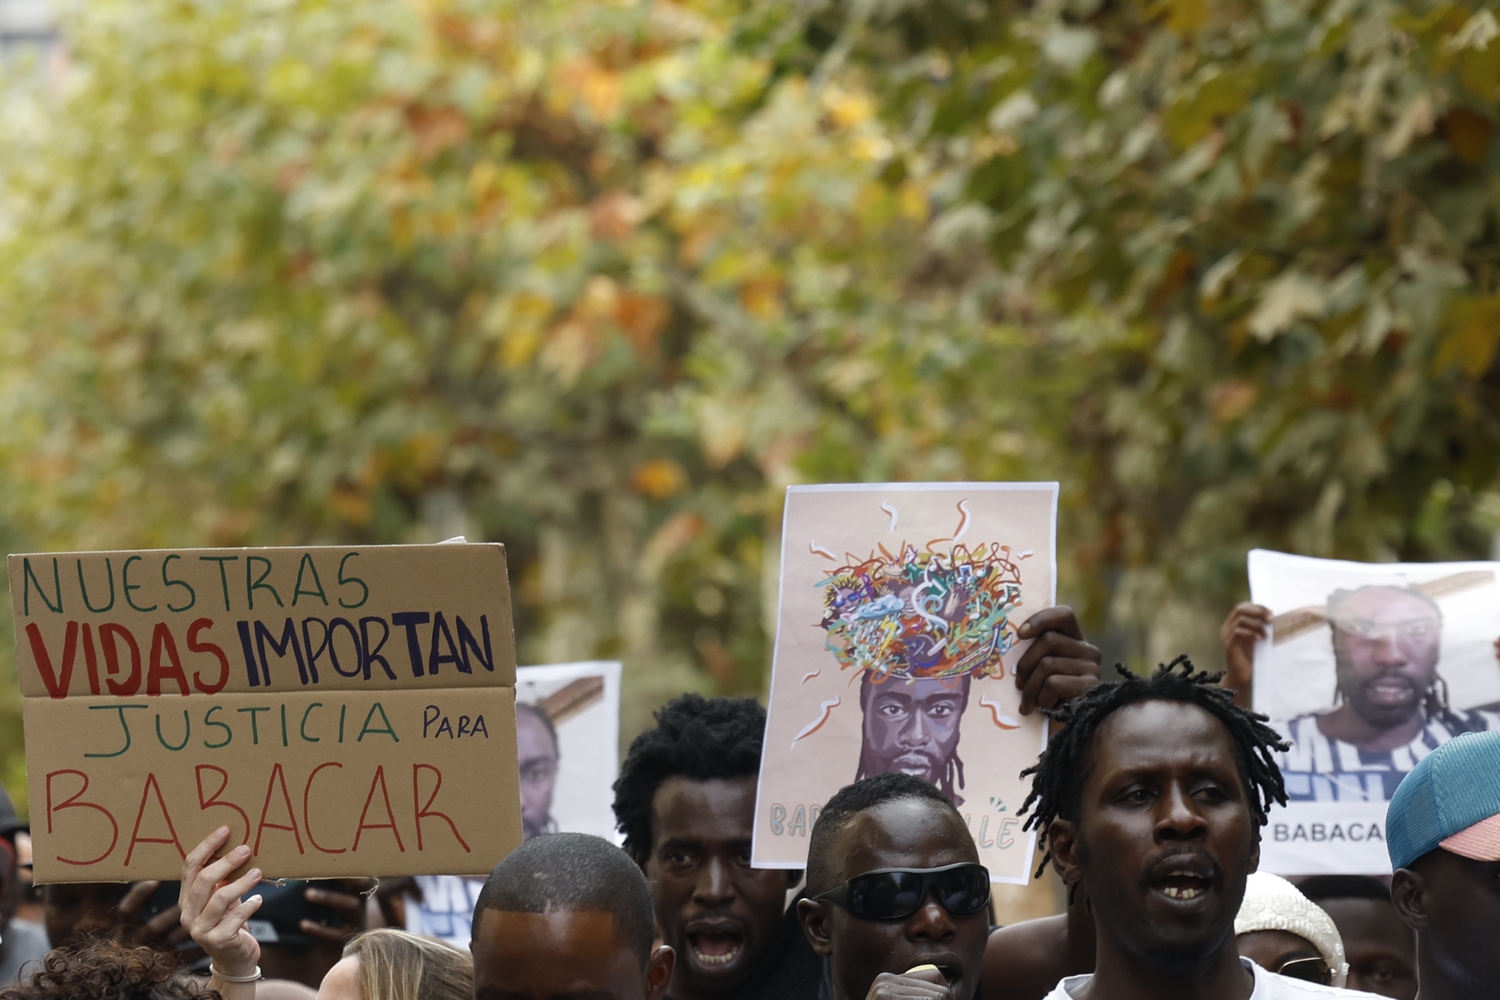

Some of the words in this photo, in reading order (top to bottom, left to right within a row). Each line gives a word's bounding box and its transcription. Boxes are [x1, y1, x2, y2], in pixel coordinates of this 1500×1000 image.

[22, 551, 369, 616] NUESTRAS
[26, 617, 230, 699] VIDAS
[236, 611, 495, 687] IMPORTAN
[84, 702, 400, 758] JUSTICIA
[422, 704, 489, 740] PARA
[46, 762, 471, 866] BABACAR
[1273, 822, 1384, 843] BABACA
